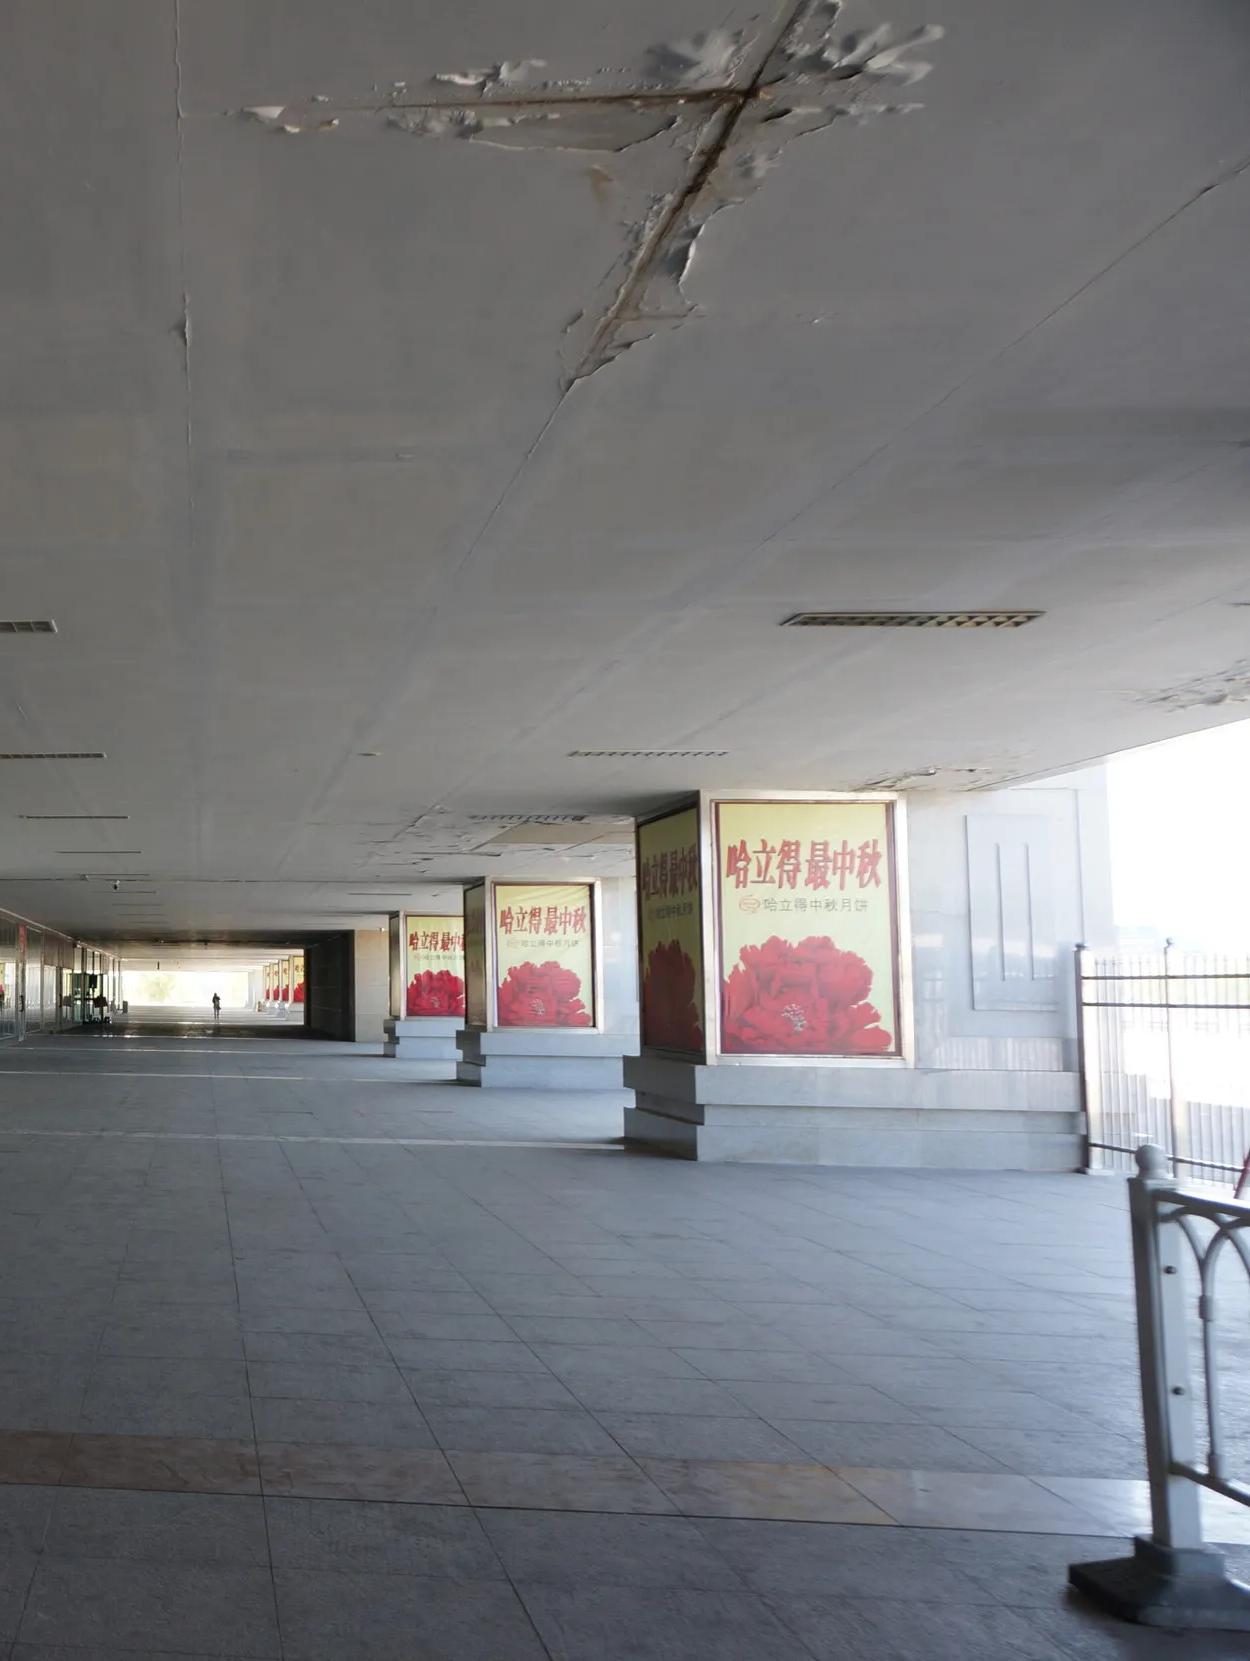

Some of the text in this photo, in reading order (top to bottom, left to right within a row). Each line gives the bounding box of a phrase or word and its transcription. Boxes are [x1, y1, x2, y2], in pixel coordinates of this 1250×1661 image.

[641, 842, 698, 901] 哈立得最中秋
[725, 838, 883, 891] 哈立得最中秋
[499, 905, 587, 935] 哈立得最中秋
[762, 897, 869, 914] 哈立得中秋月饼
